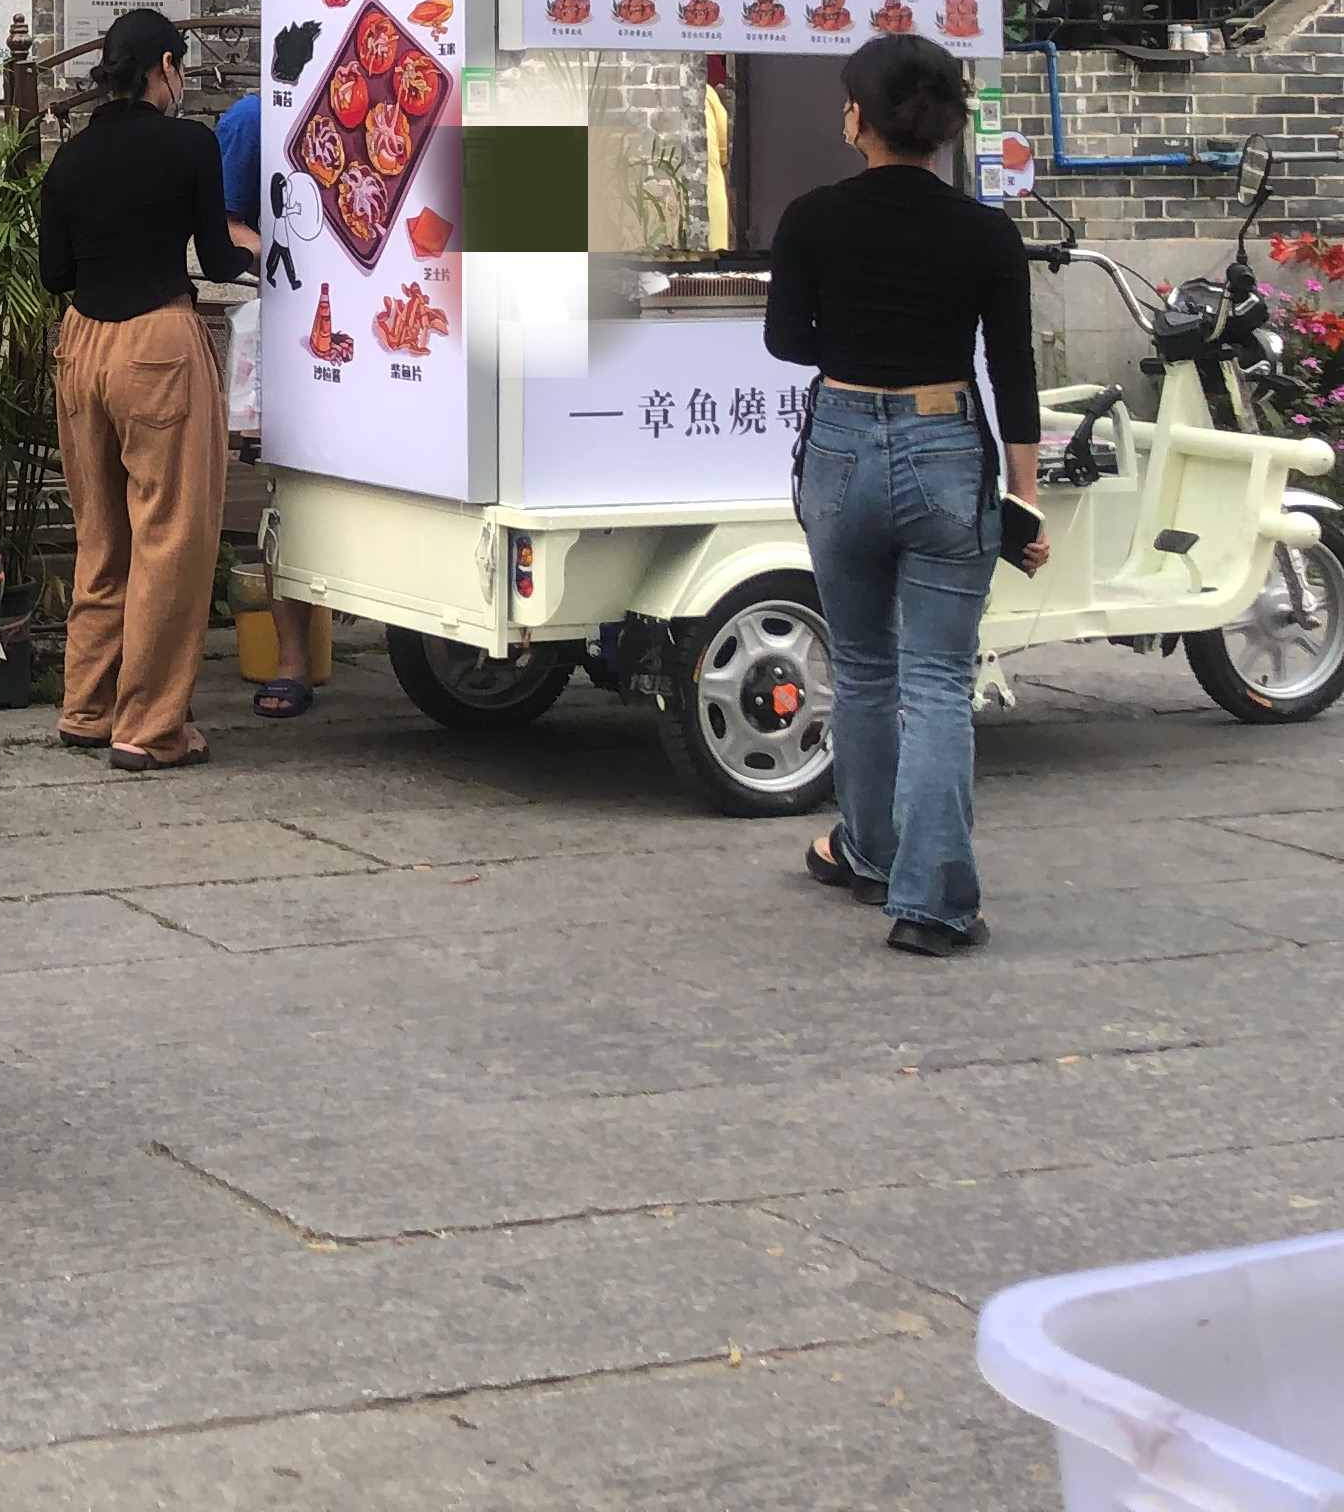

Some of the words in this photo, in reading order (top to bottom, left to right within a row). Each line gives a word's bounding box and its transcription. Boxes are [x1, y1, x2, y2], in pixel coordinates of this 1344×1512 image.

[438, 42, 456, 56] 玉米
[273, 90, 292, 108] 海苔
[390, 362, 422, 383] 柴鱼片
